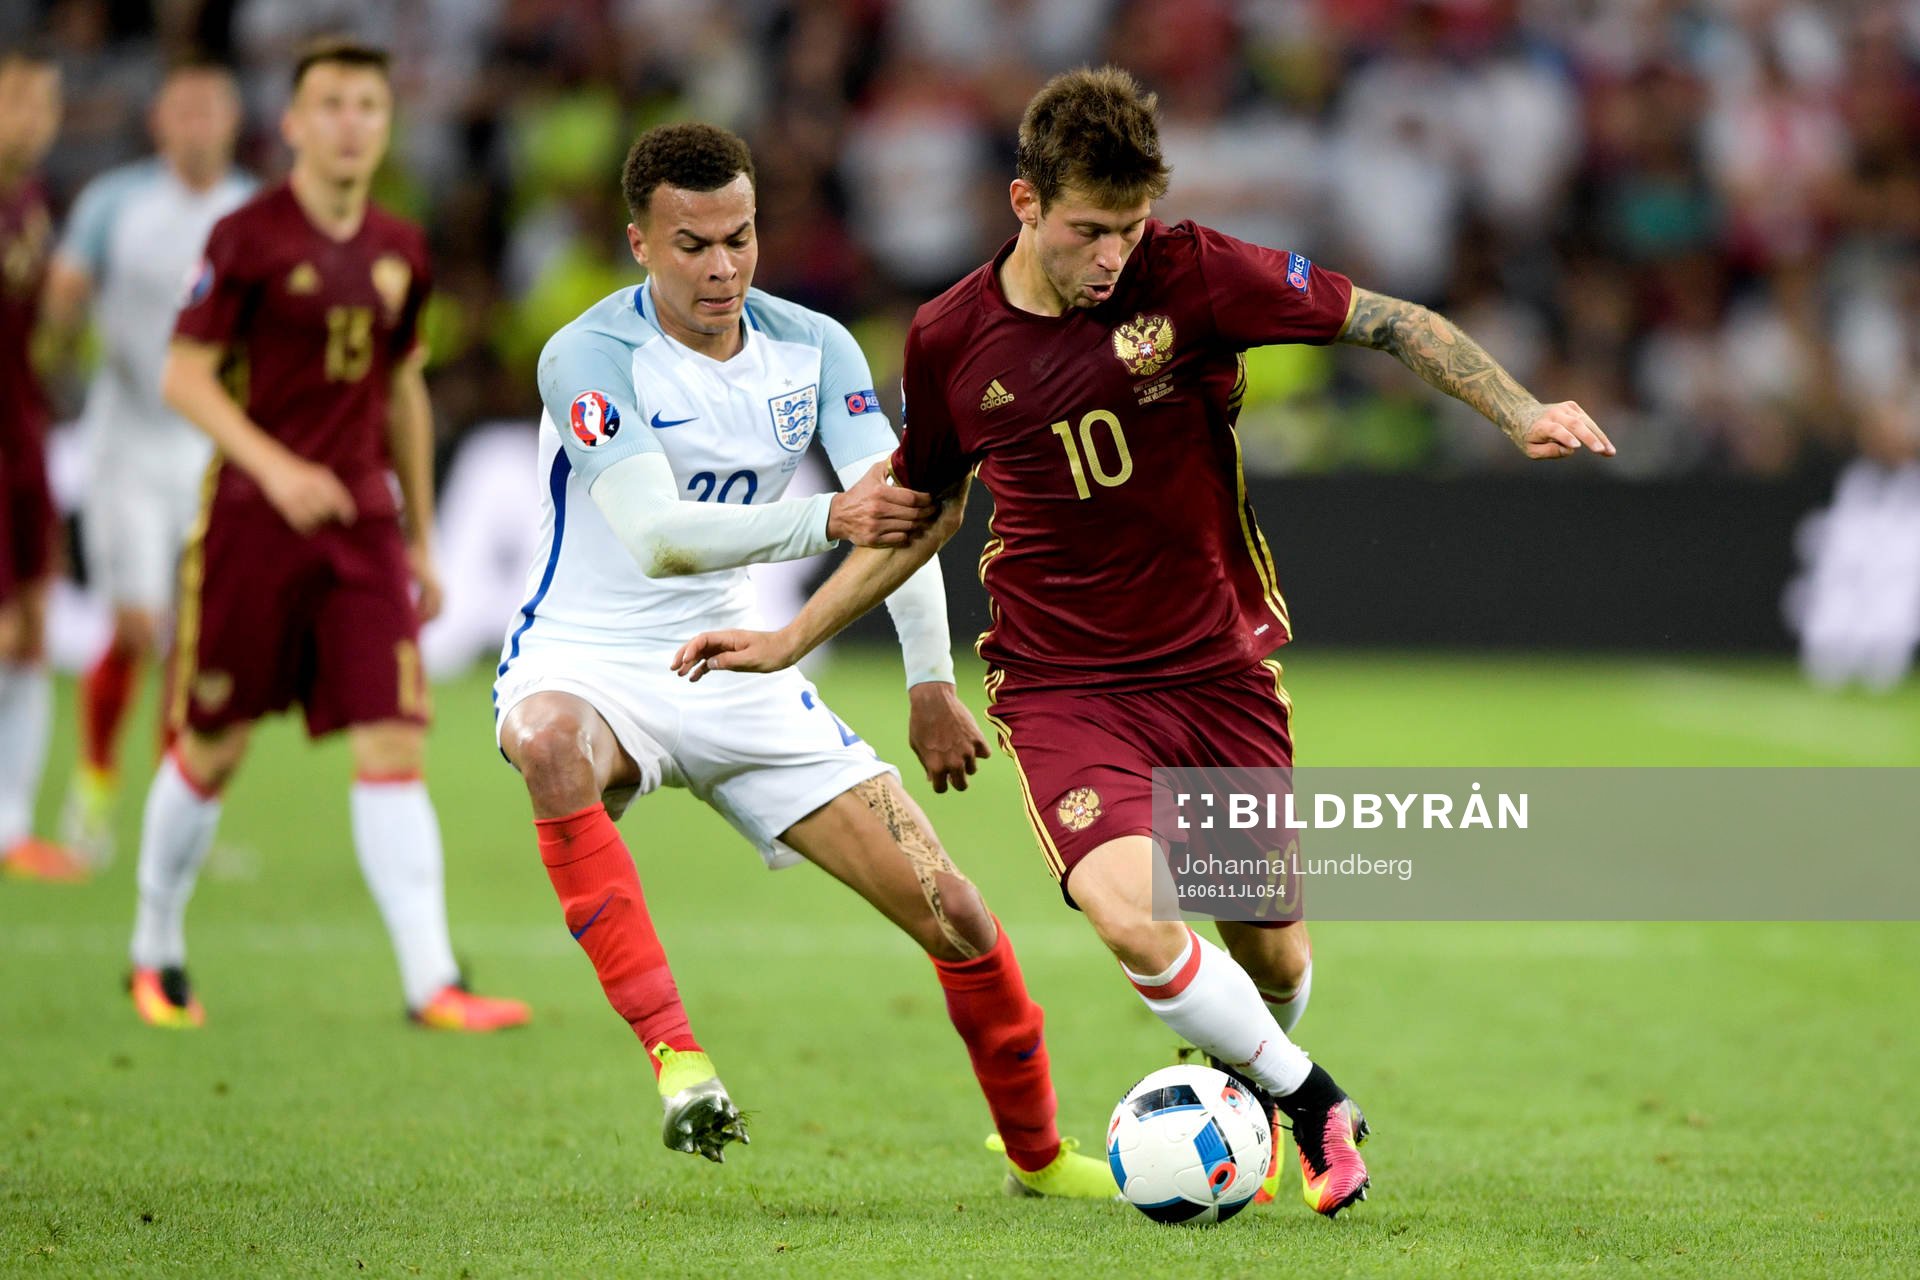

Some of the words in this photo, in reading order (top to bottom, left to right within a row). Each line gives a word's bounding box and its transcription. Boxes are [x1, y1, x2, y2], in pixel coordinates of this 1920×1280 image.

[980, 393, 1015, 411] adidas
[1051, 409, 1134, 500] 10
[687, 469, 758, 505] 20
